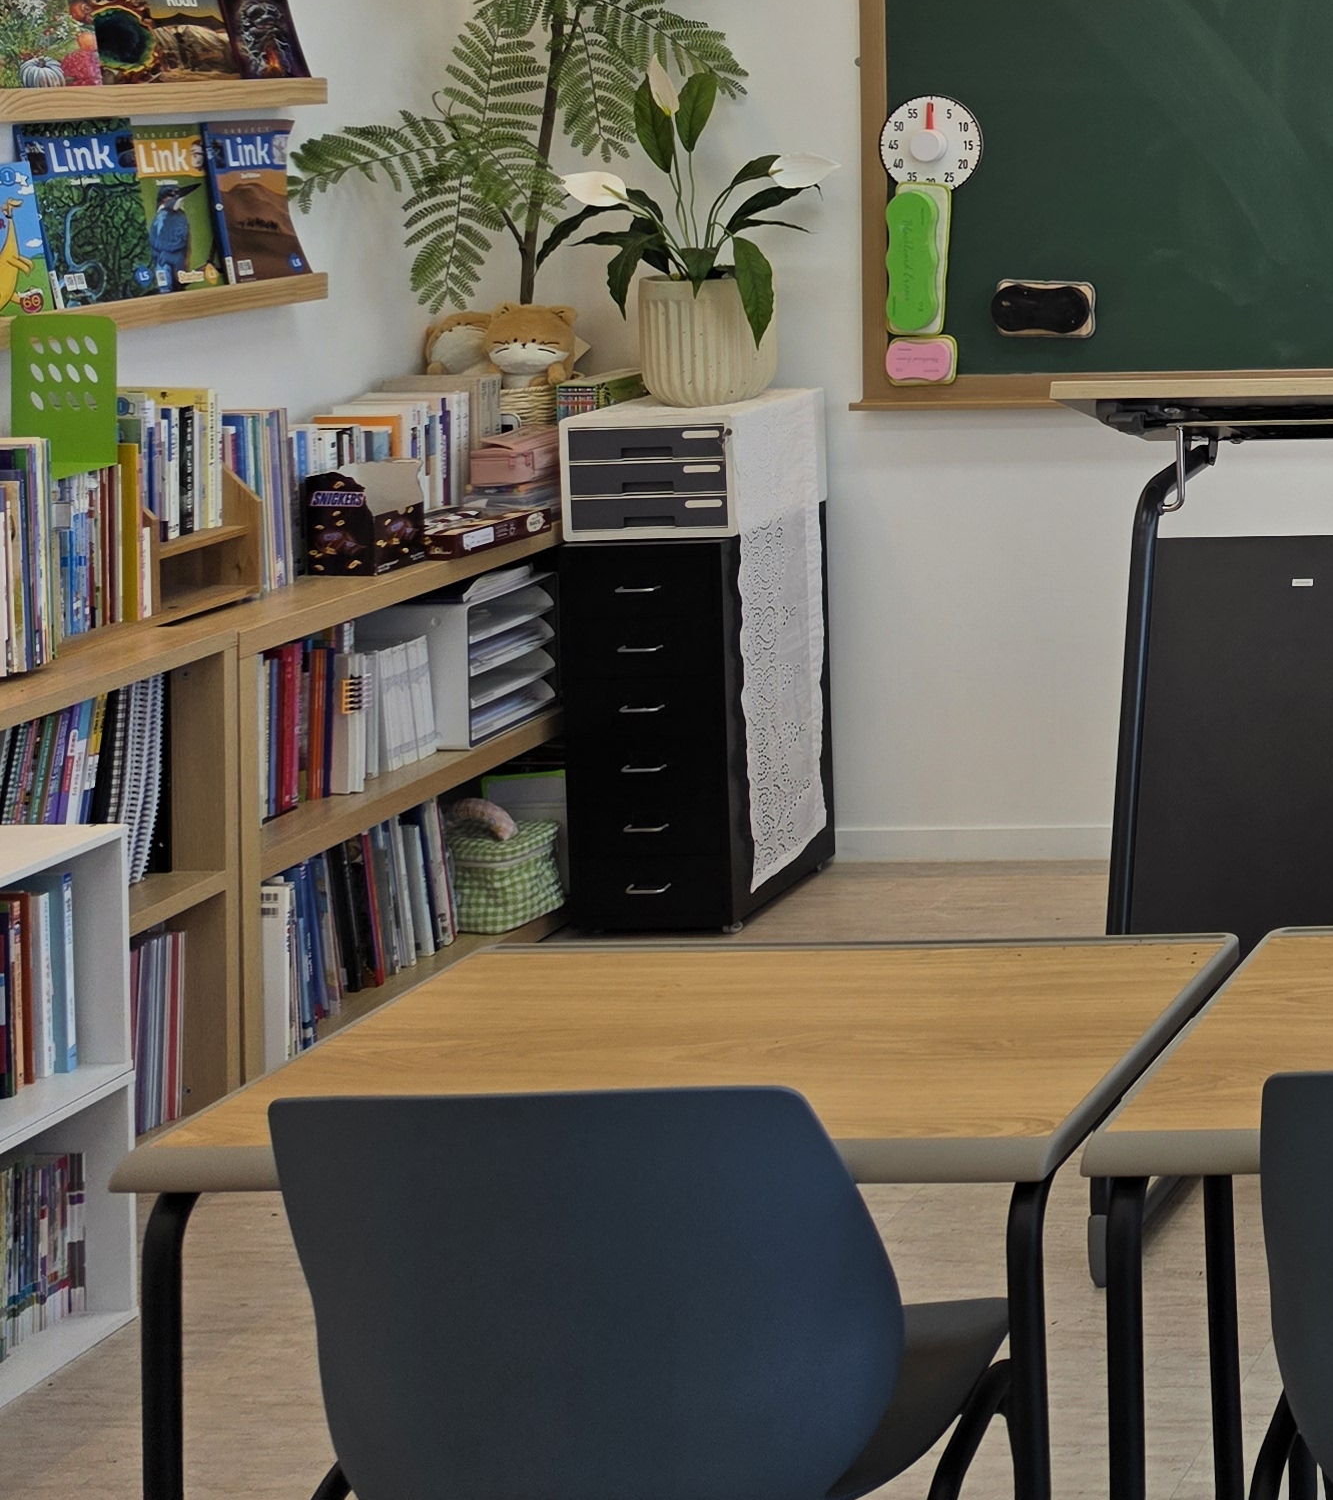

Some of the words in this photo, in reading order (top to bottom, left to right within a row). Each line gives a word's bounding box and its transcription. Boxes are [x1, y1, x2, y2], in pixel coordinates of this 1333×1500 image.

[907, 108, 918, 119] 55
[946, 109, 952, 119] 5
[893, 121, 904, 132] 50
[958, 122, 969, 132] 10
[888, 140, 899, 150] 45
[963, 140, 974, 151] 15
[48, 138, 115, 174] Link
[138, 141, 190, 173] Link
[225, 135, 271, 168] Link
[893, 159, 904, 169] 40
[958, 159, 968, 169] 20
[907, 172, 917, 182] 35
[944, 172, 955, 183] 25
[139, 271, 150, 282] L5
[22, 296, 41, 309] 60
[312, 491, 365, 507] SNICKERS
